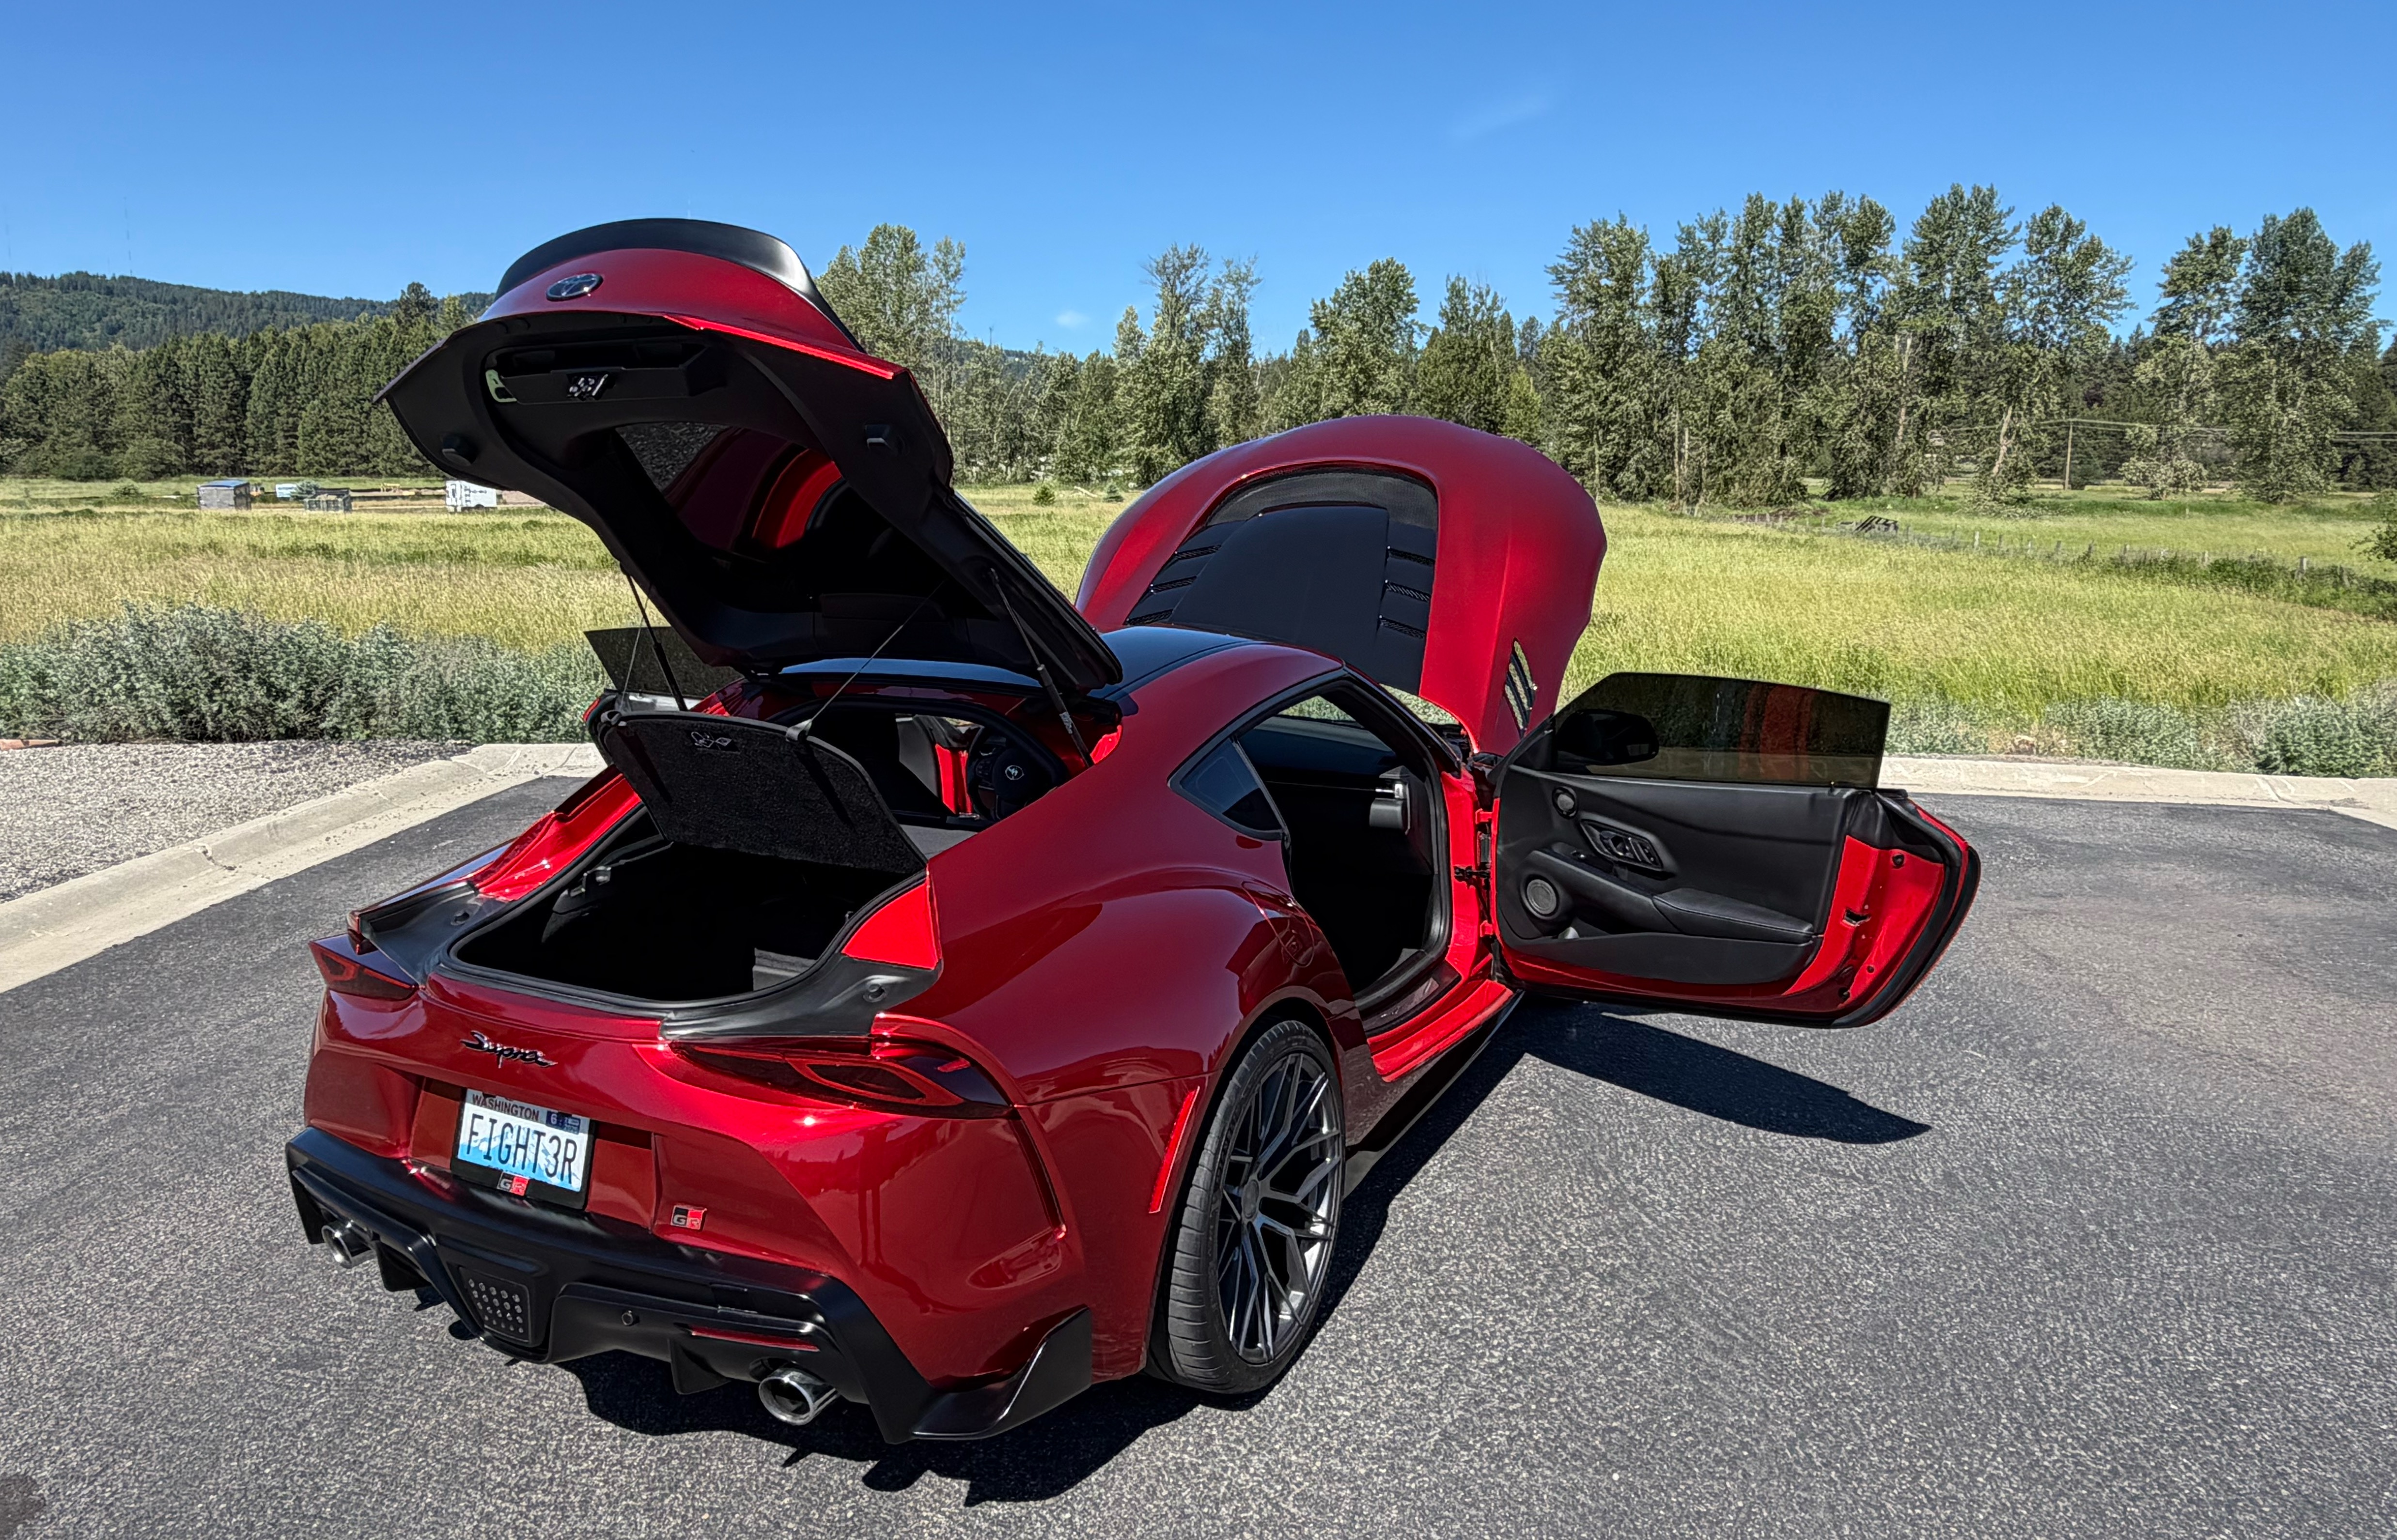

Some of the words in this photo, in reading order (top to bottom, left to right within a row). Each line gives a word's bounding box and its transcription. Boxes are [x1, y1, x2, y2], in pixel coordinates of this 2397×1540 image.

[460, 1030, 558, 1069] Supra
[472, 1094, 540, 1121] WASHINGTON
[466, 1114, 577, 1184] FIGHT3R
